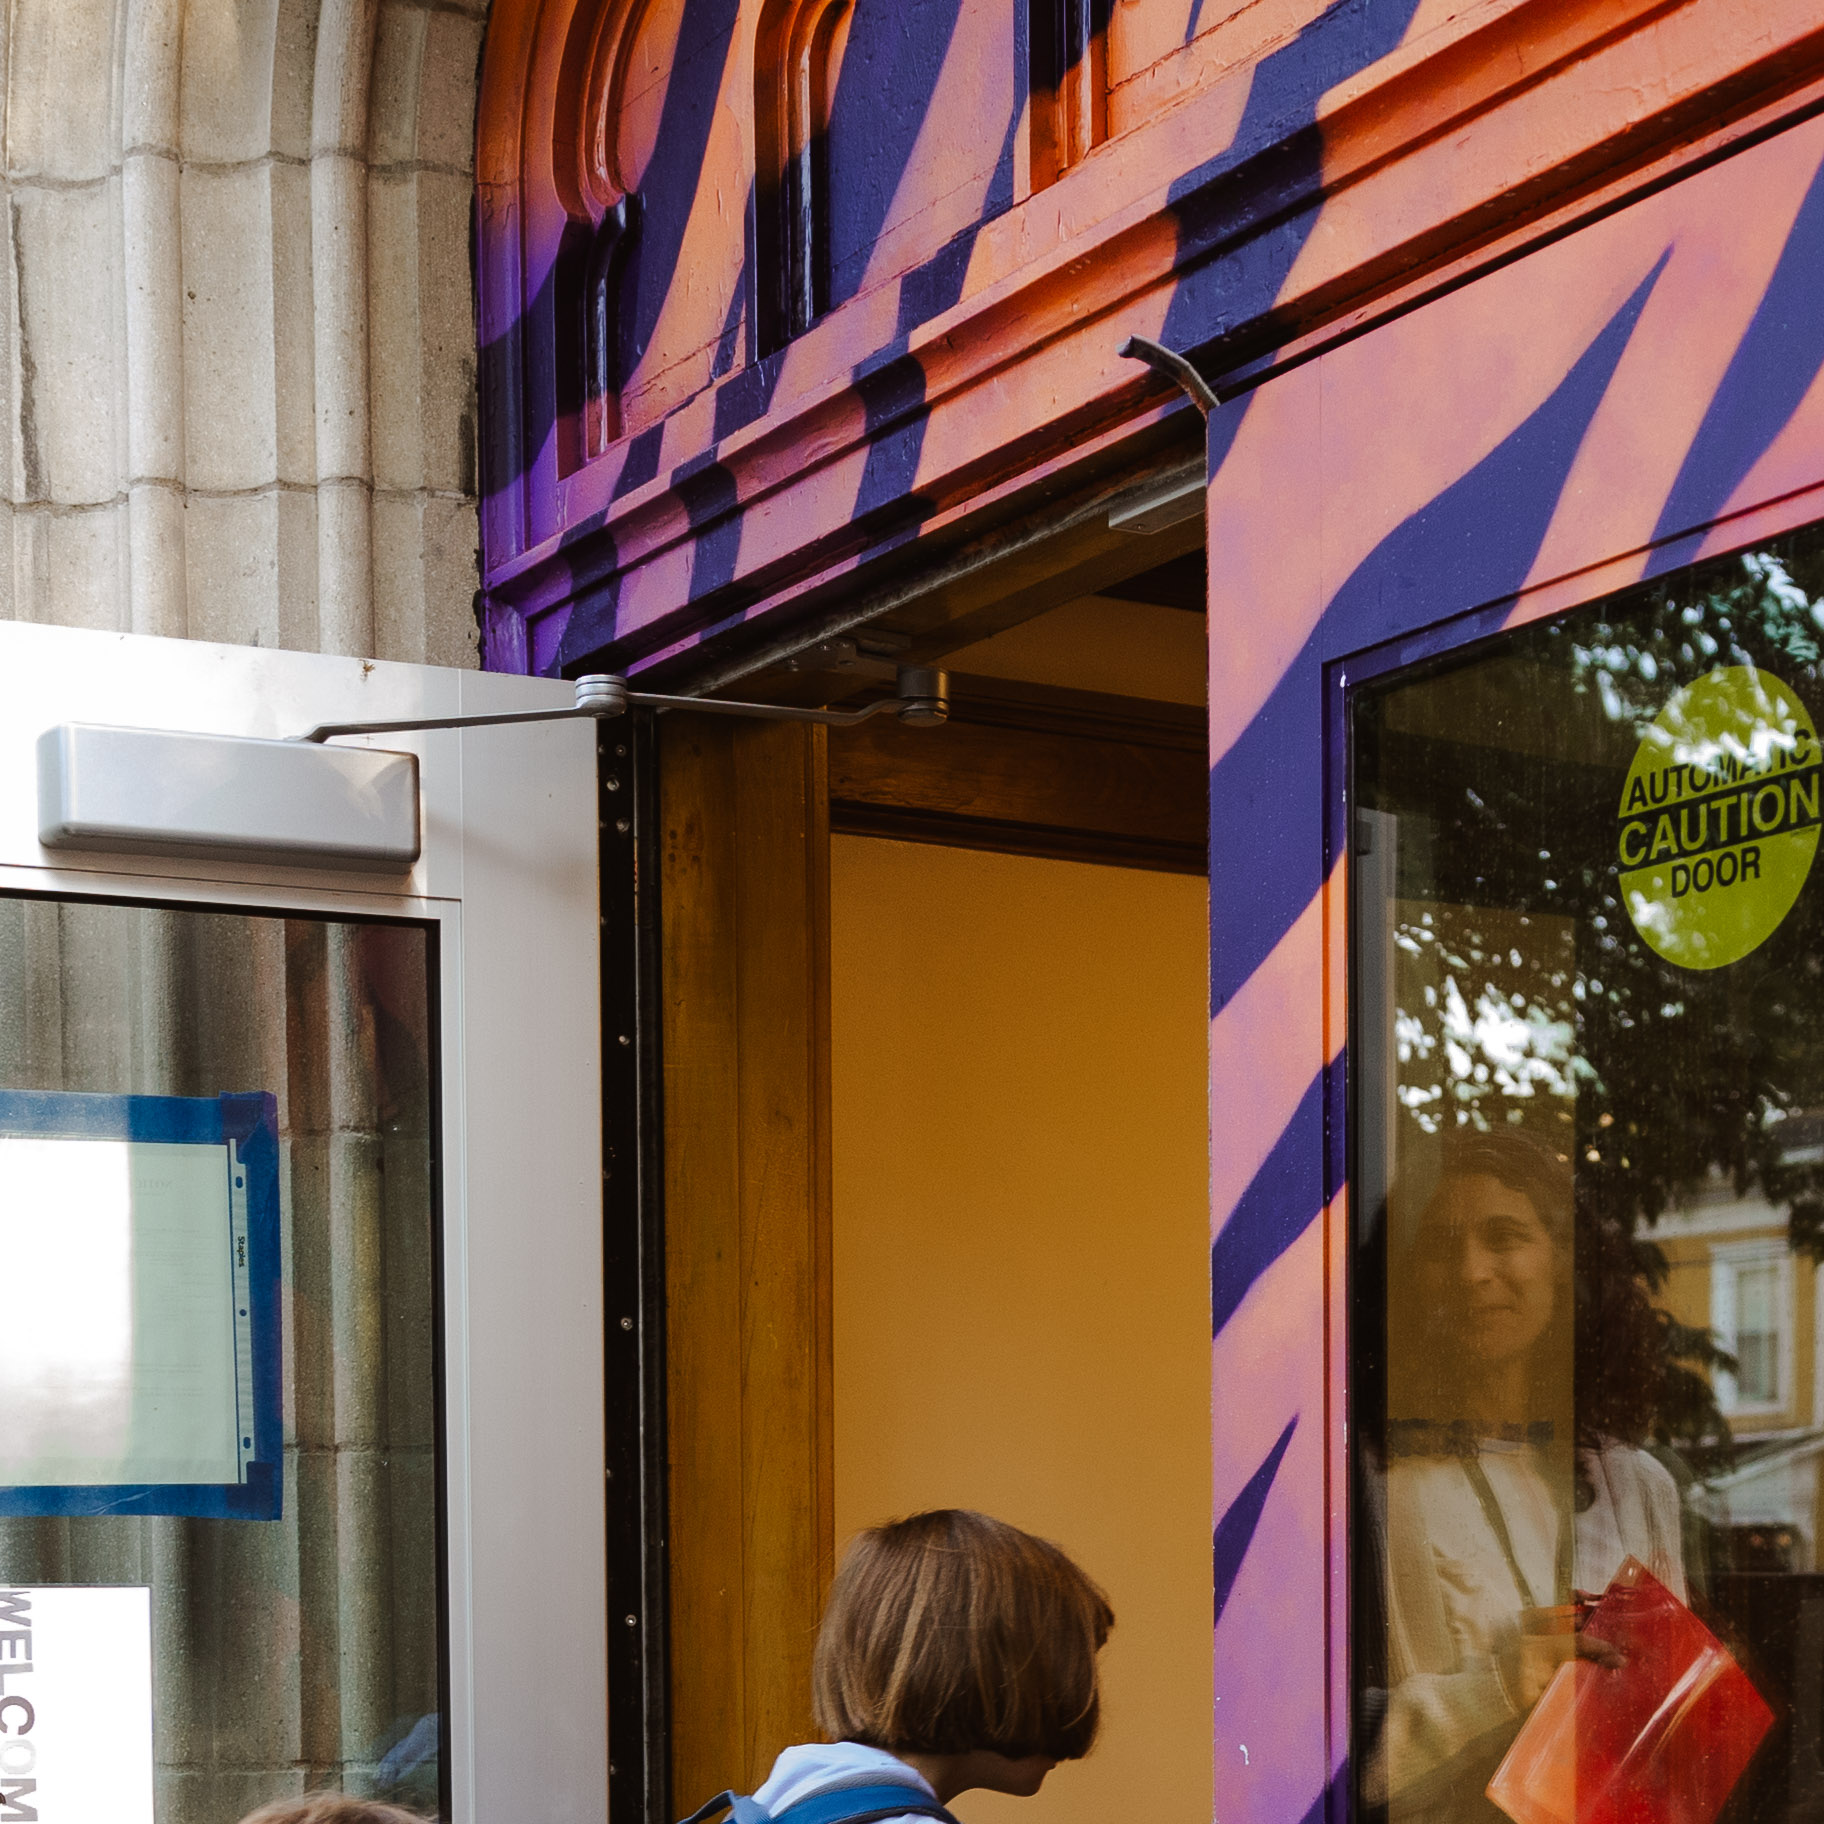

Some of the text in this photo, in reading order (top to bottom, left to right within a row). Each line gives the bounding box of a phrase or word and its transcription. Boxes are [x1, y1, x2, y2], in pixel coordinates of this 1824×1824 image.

[1628, 728, 1811, 811] AUTOMIC
[1620, 774, 1819, 866] CAUTION
[1672, 846, 1761, 898] DOOR
[237, 1236, 245, 1268] Staples
